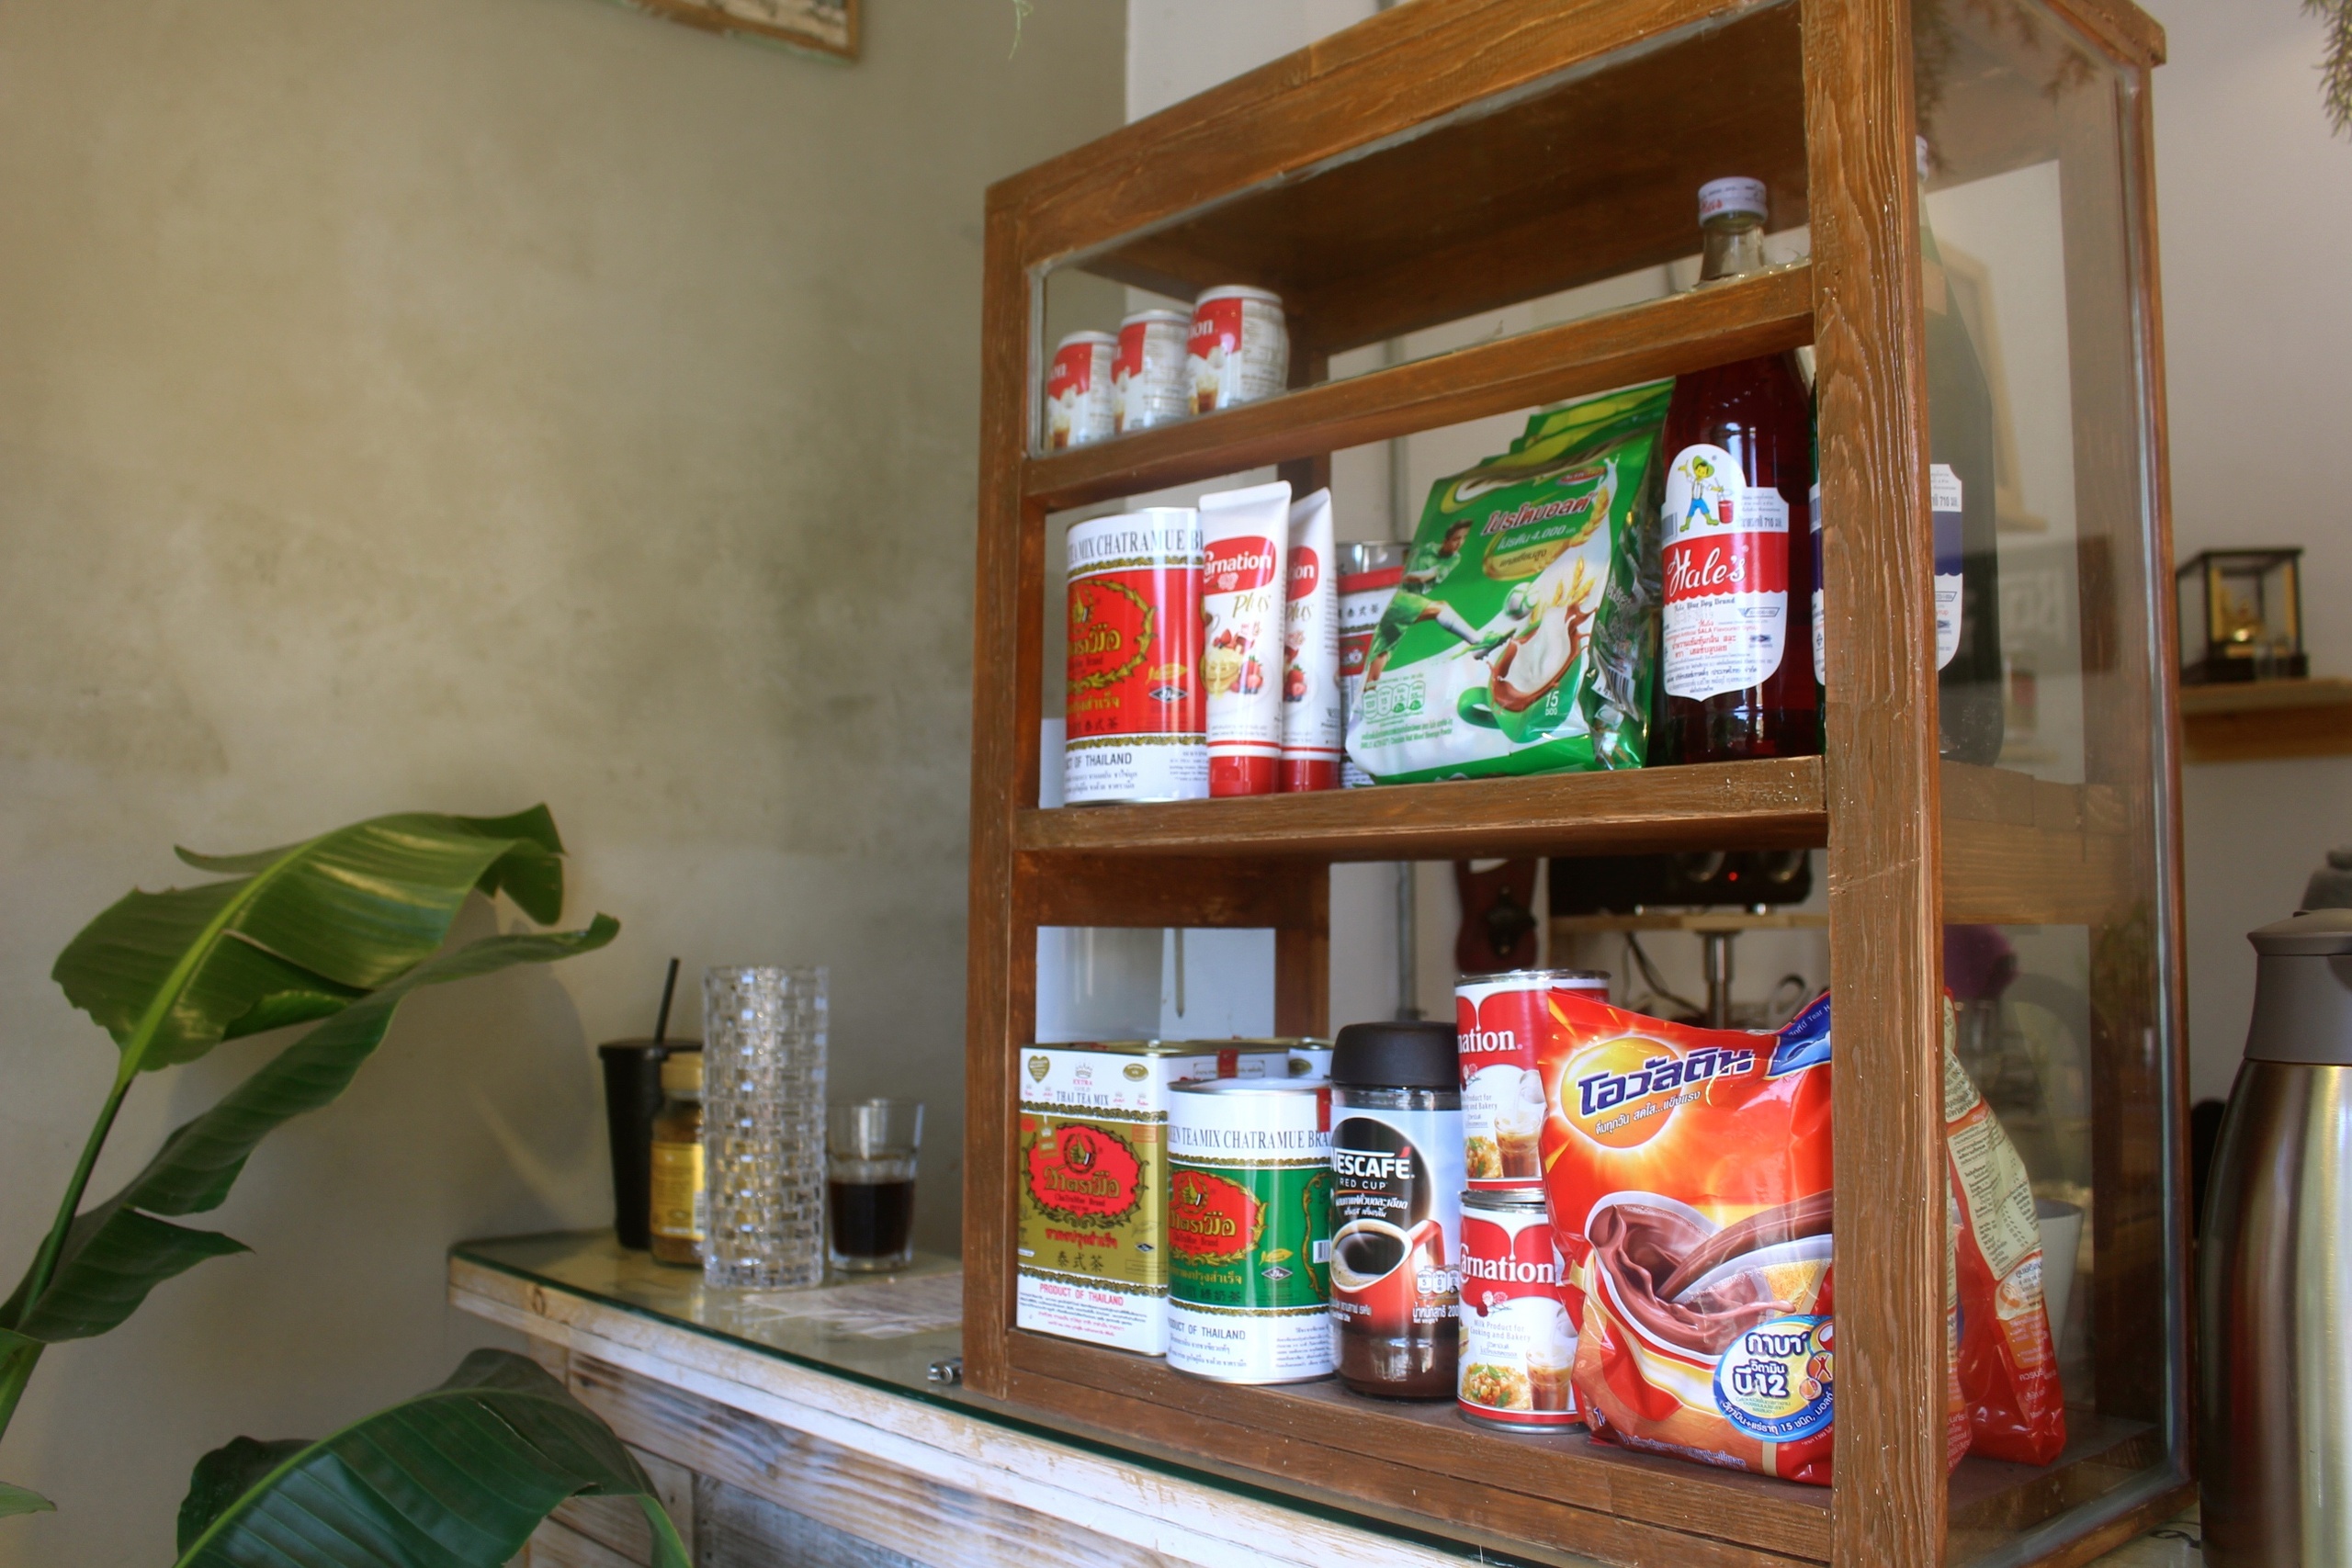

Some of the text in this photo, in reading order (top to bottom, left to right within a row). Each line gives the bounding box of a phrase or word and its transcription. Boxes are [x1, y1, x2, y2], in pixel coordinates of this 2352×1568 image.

[1667, 547, 1746, 597] Hale's
[1936, 608, 1949, 616] yrup
[1545, 690, 1560, 707] 15
[1086, 752, 1132, 766] THAILAND
[1807, 1010, 1823, 1022] Tear
[1578, 1047, 1754, 1118] โอวัลติน
[1057, 1090, 1074, 1103] THAI
[1077, 1092, 1092, 1104] TEA
[1094, 1094, 1109, 1106] MIX
[1596, 1113, 1630, 1135] ดื่มทุกวัน
[1044, 1164, 1120, 1198] ชาตรามือ
[1340, 1178, 1385, 1190] RED CUP
[1170, 1211, 1236, 1236] าตรามือ
[1057, 1250, 1103, 1272] 泰式茶
[1039, 1283, 1125, 1306] PRODUCT OF THAILAND
[1188, 1323, 1197, 1335] OF
[1202, 1326, 1246, 1340] THAILAND
[1474, 1318, 1525, 1332] Milk Product for
[1470, 1326, 1532, 1342] Cooking and Bakery
[1749, 1359, 1786, 1374] วิตามิน
[1781, 1423, 1792, 1432] 15
